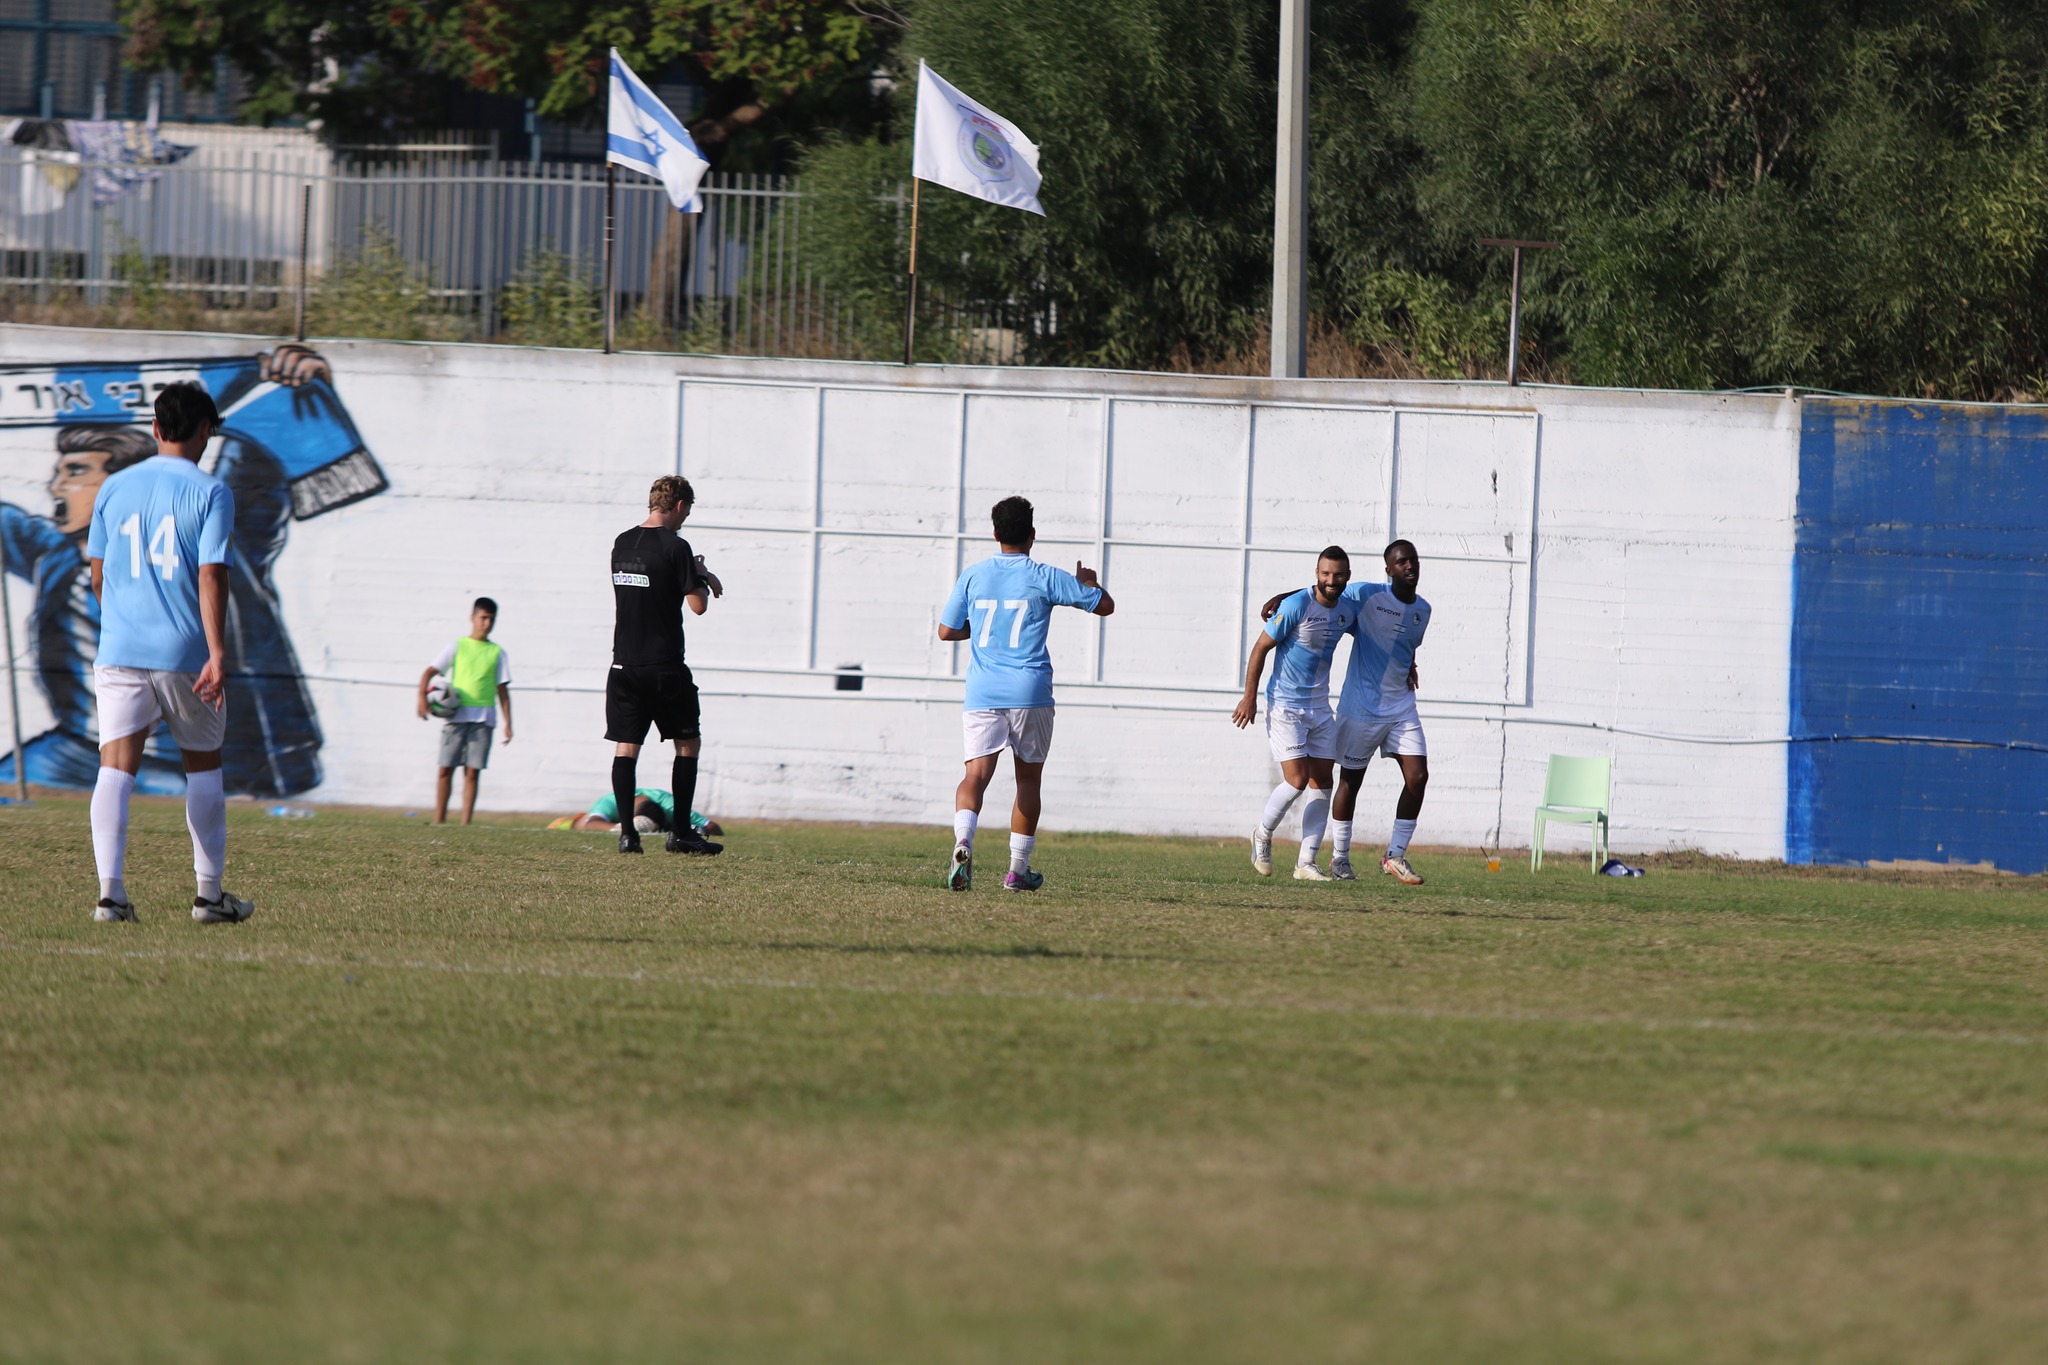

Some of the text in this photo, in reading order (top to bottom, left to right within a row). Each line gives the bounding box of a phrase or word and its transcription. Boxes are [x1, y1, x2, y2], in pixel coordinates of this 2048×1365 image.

[17, 382, 91, 410] אור
[119, 513, 180, 581] 14
[974, 599, 1029, 648] 77
